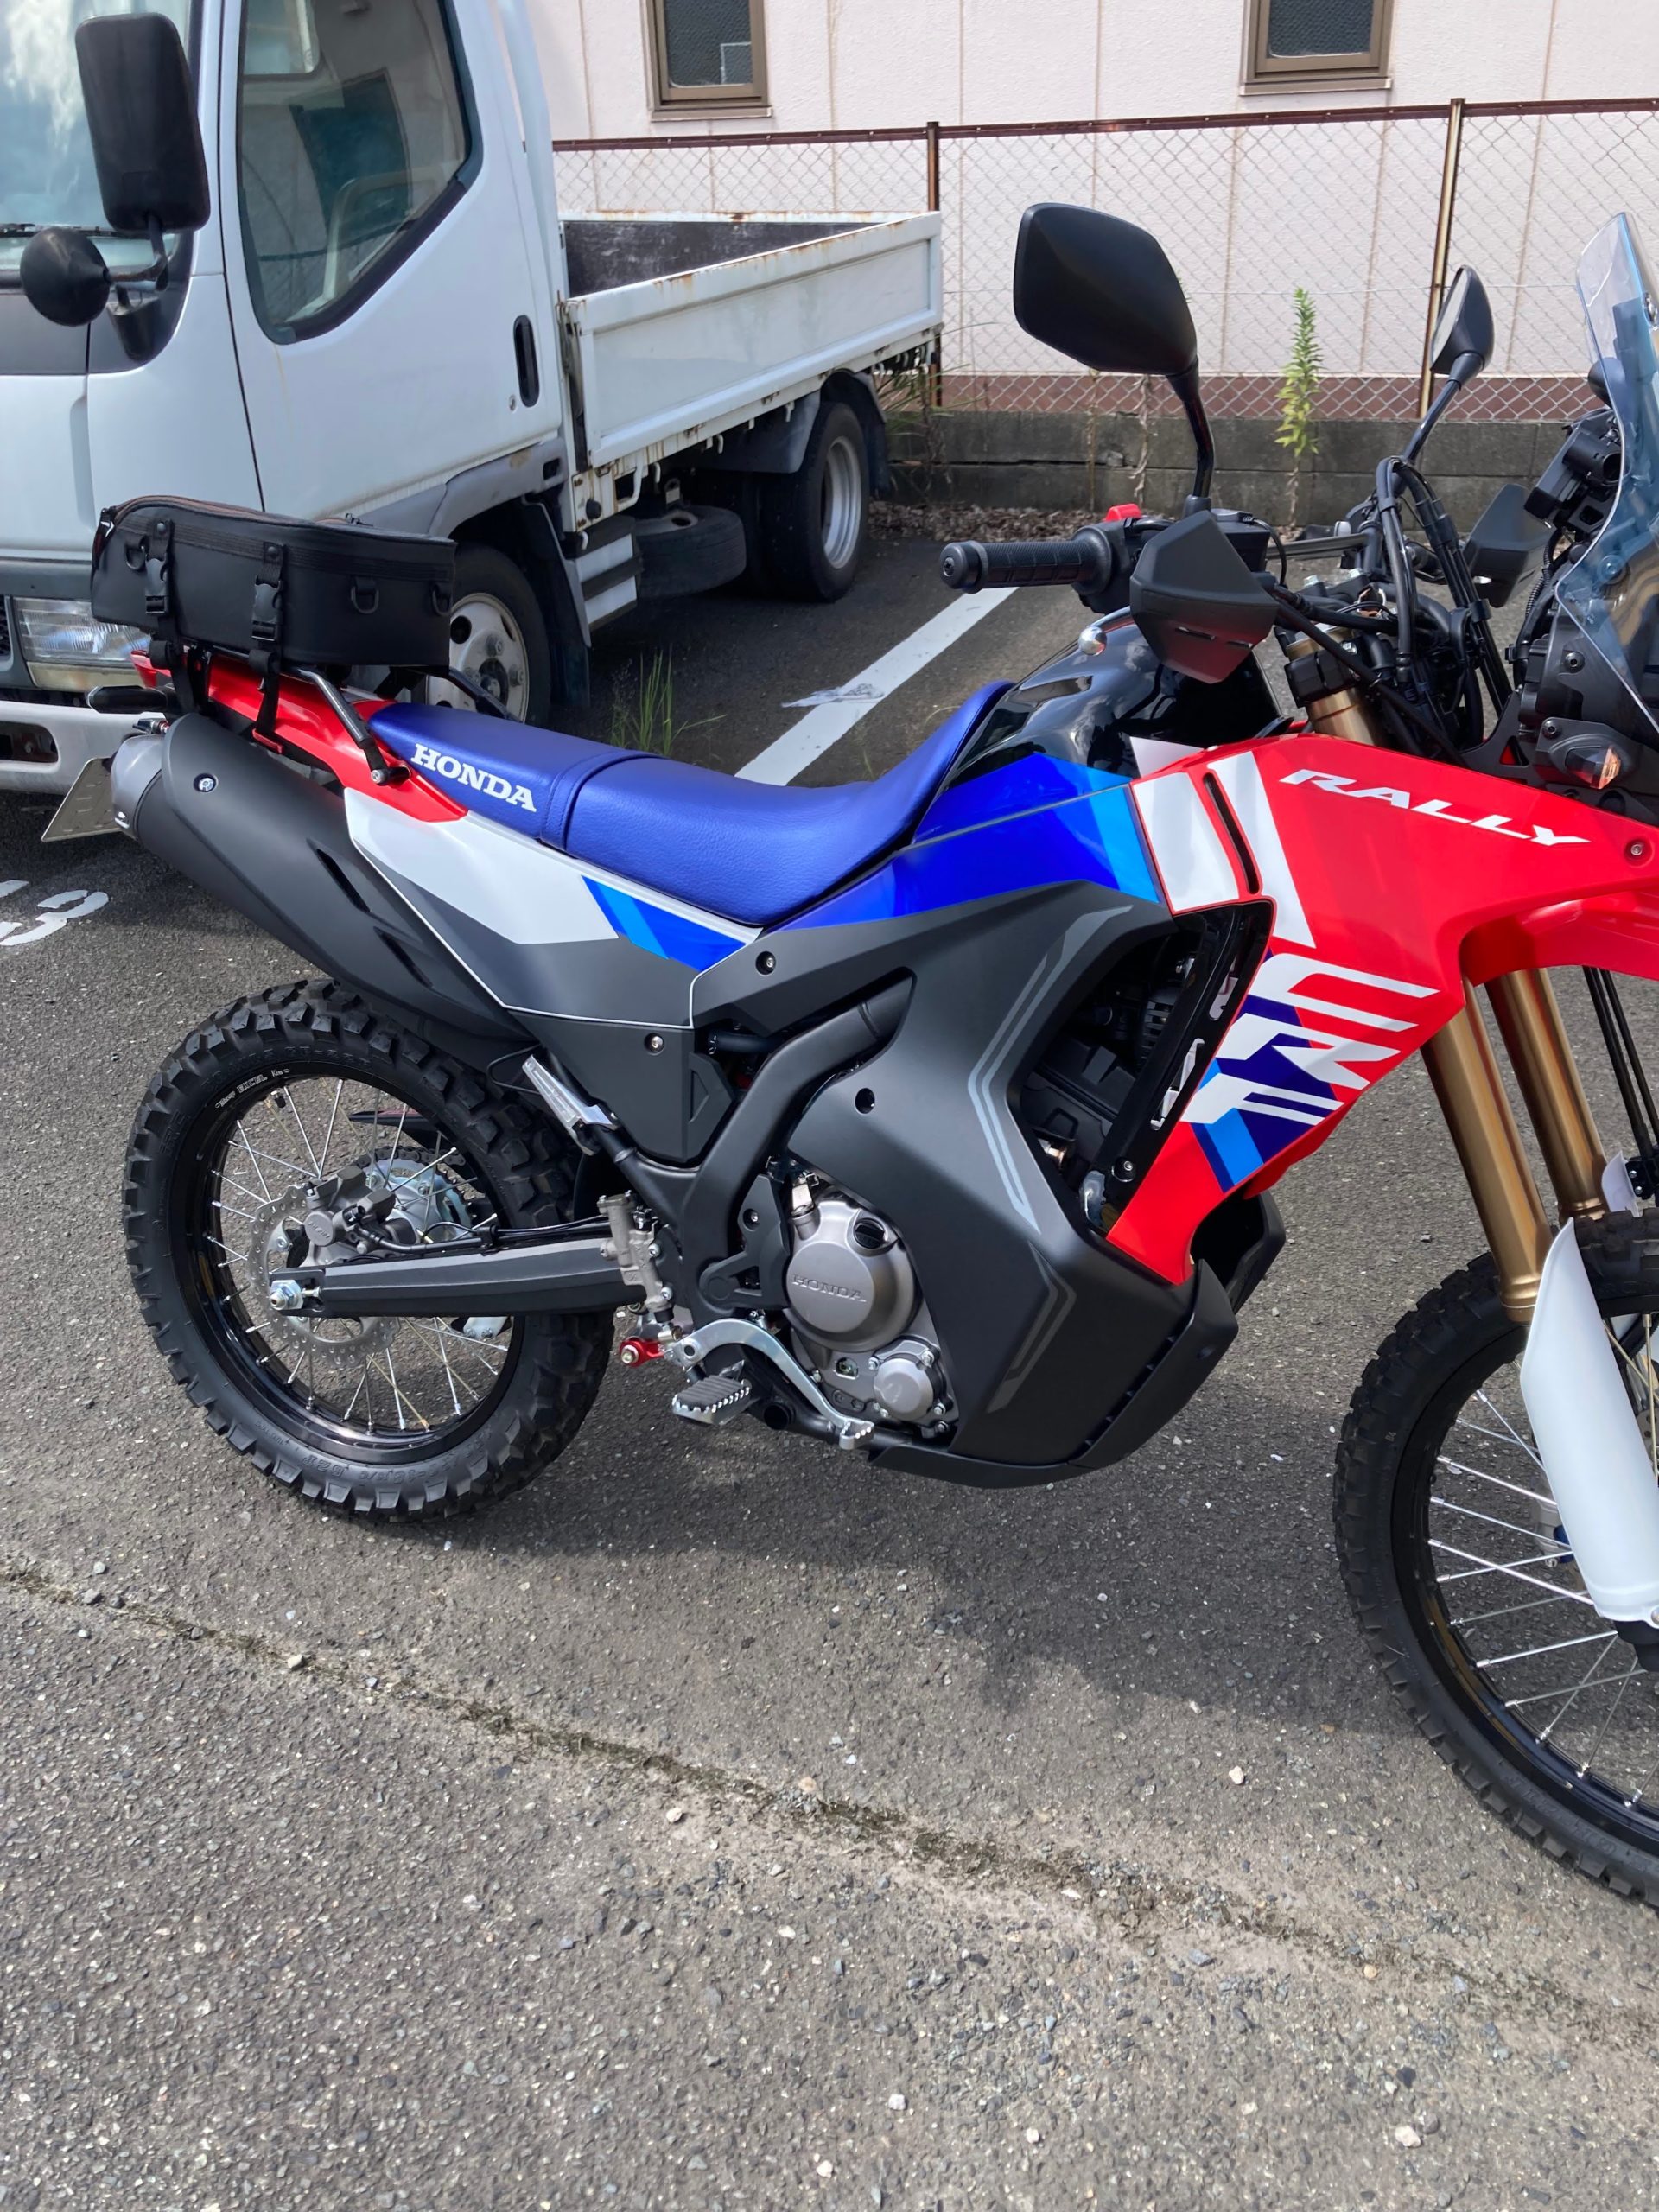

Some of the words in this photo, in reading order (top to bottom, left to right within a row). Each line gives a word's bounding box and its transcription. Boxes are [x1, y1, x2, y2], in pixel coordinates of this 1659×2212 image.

[410, 743, 537, 812] HONDA
[1279, 769, 1592, 846] RALLY
[1179, 953, 1441, 1126] CRF
[791, 1274, 868, 1303] HONDA
